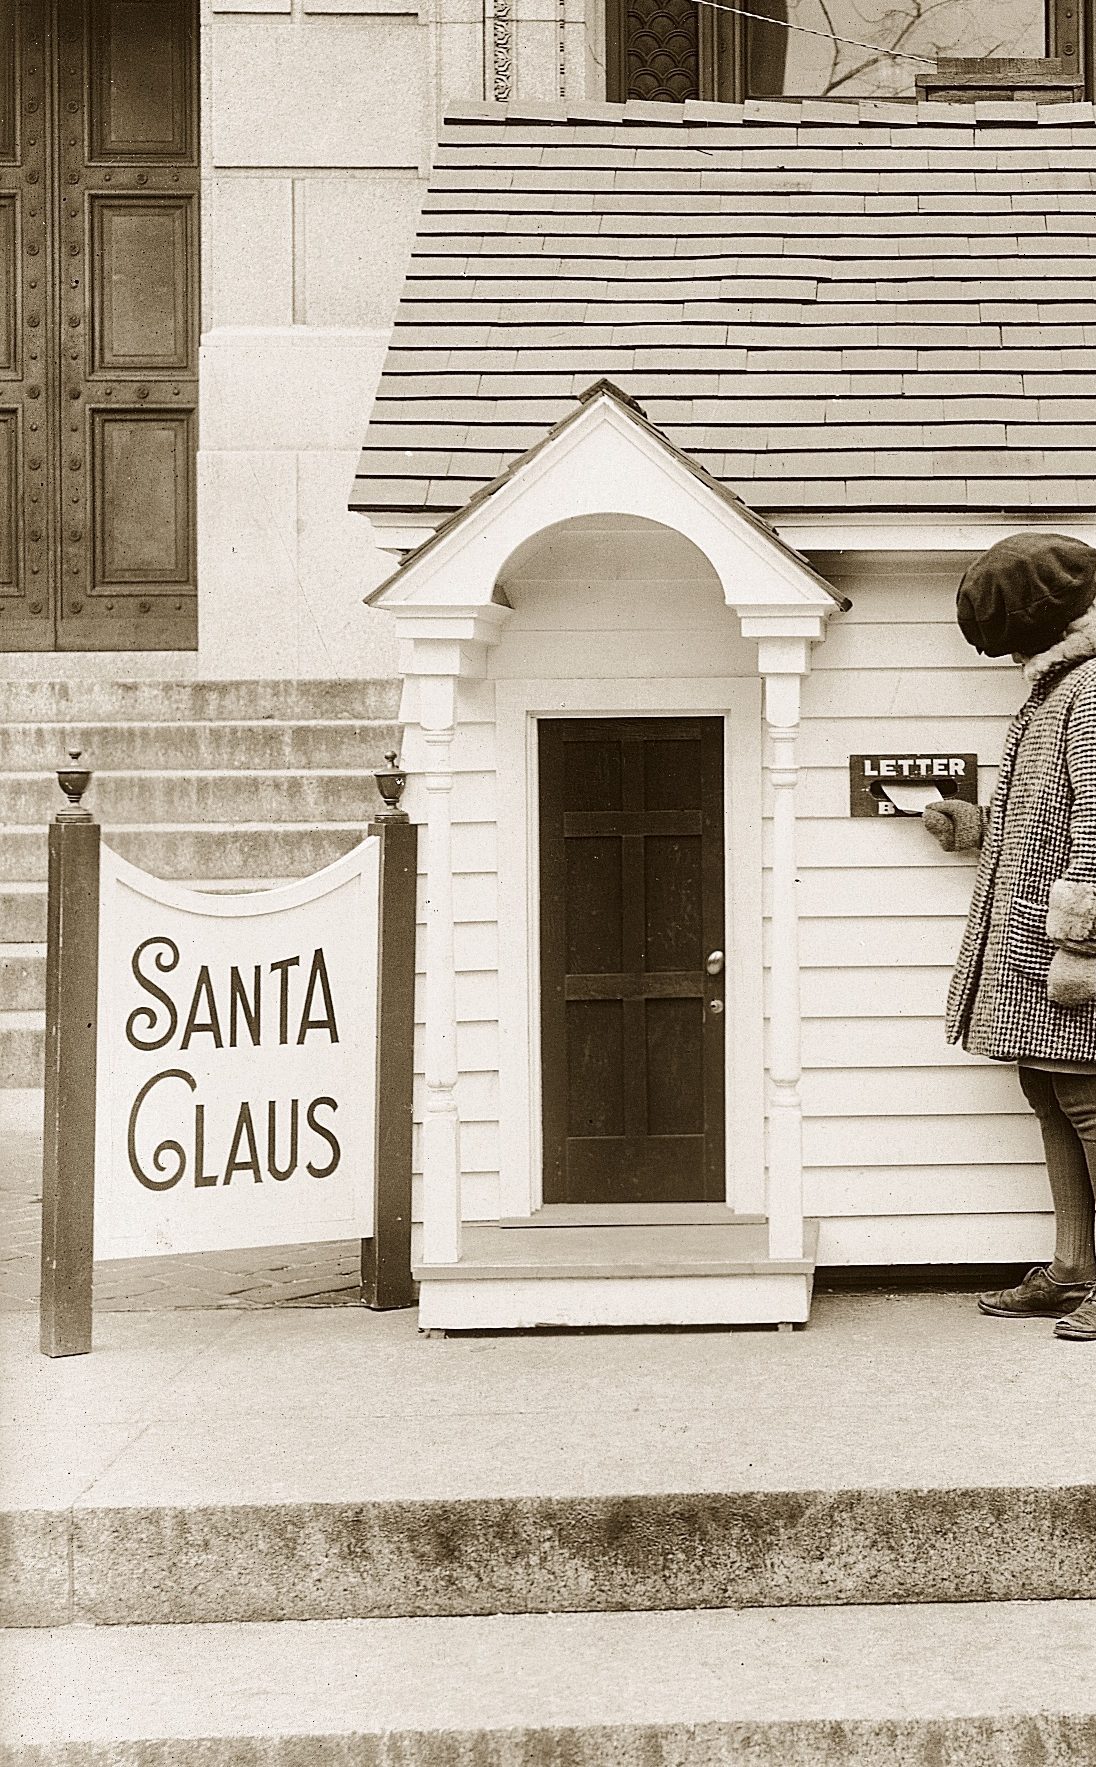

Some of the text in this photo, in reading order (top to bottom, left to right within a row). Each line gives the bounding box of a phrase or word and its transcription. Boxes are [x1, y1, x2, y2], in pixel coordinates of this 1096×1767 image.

[864, 758, 966, 776] LETTER
[126, 937, 339, 1051] SANTA
[128, 1069, 340, 1191] CLAUS
